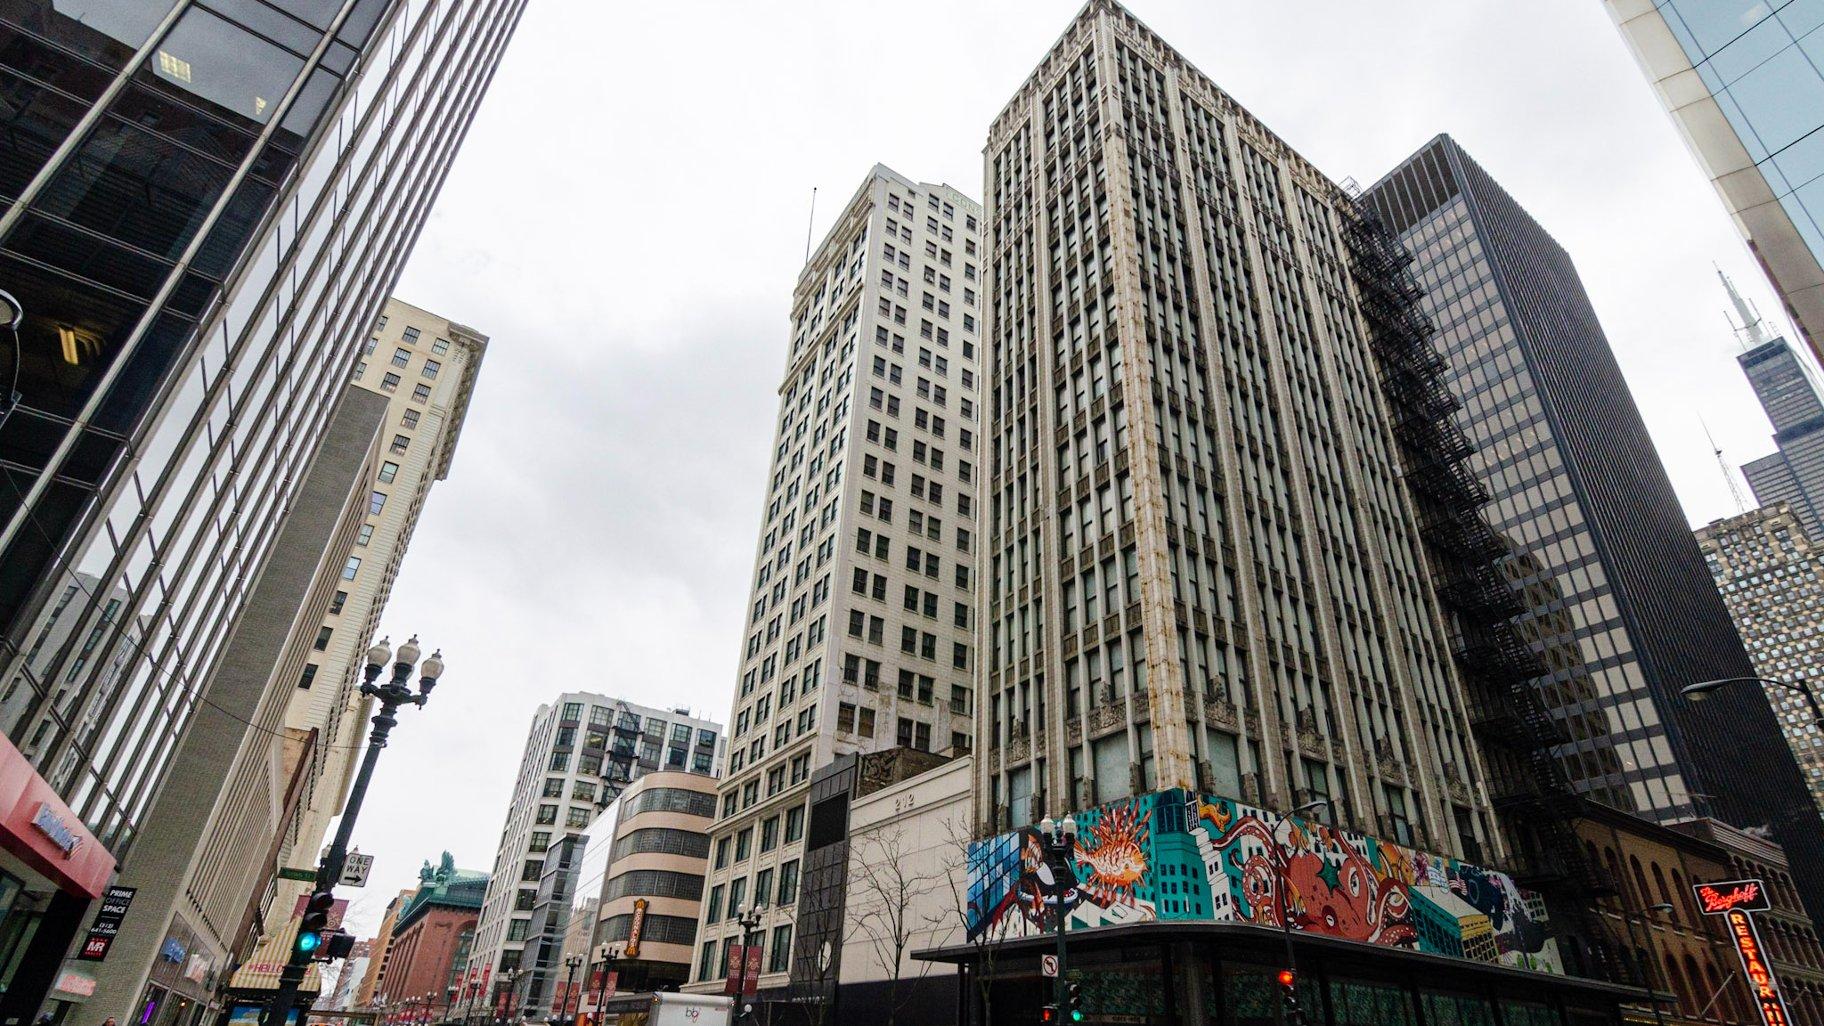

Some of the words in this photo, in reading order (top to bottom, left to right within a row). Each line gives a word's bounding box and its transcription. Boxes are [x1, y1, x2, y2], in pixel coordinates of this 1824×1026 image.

[349, 856, 369, 866] ONE
[346, 865, 368, 874] WAY
[110, 889, 133, 898] PRIME
[106, 897, 131, 906] OFFICE
[102, 904, 126, 913] SPACE
[87, 941, 105, 952] MR
